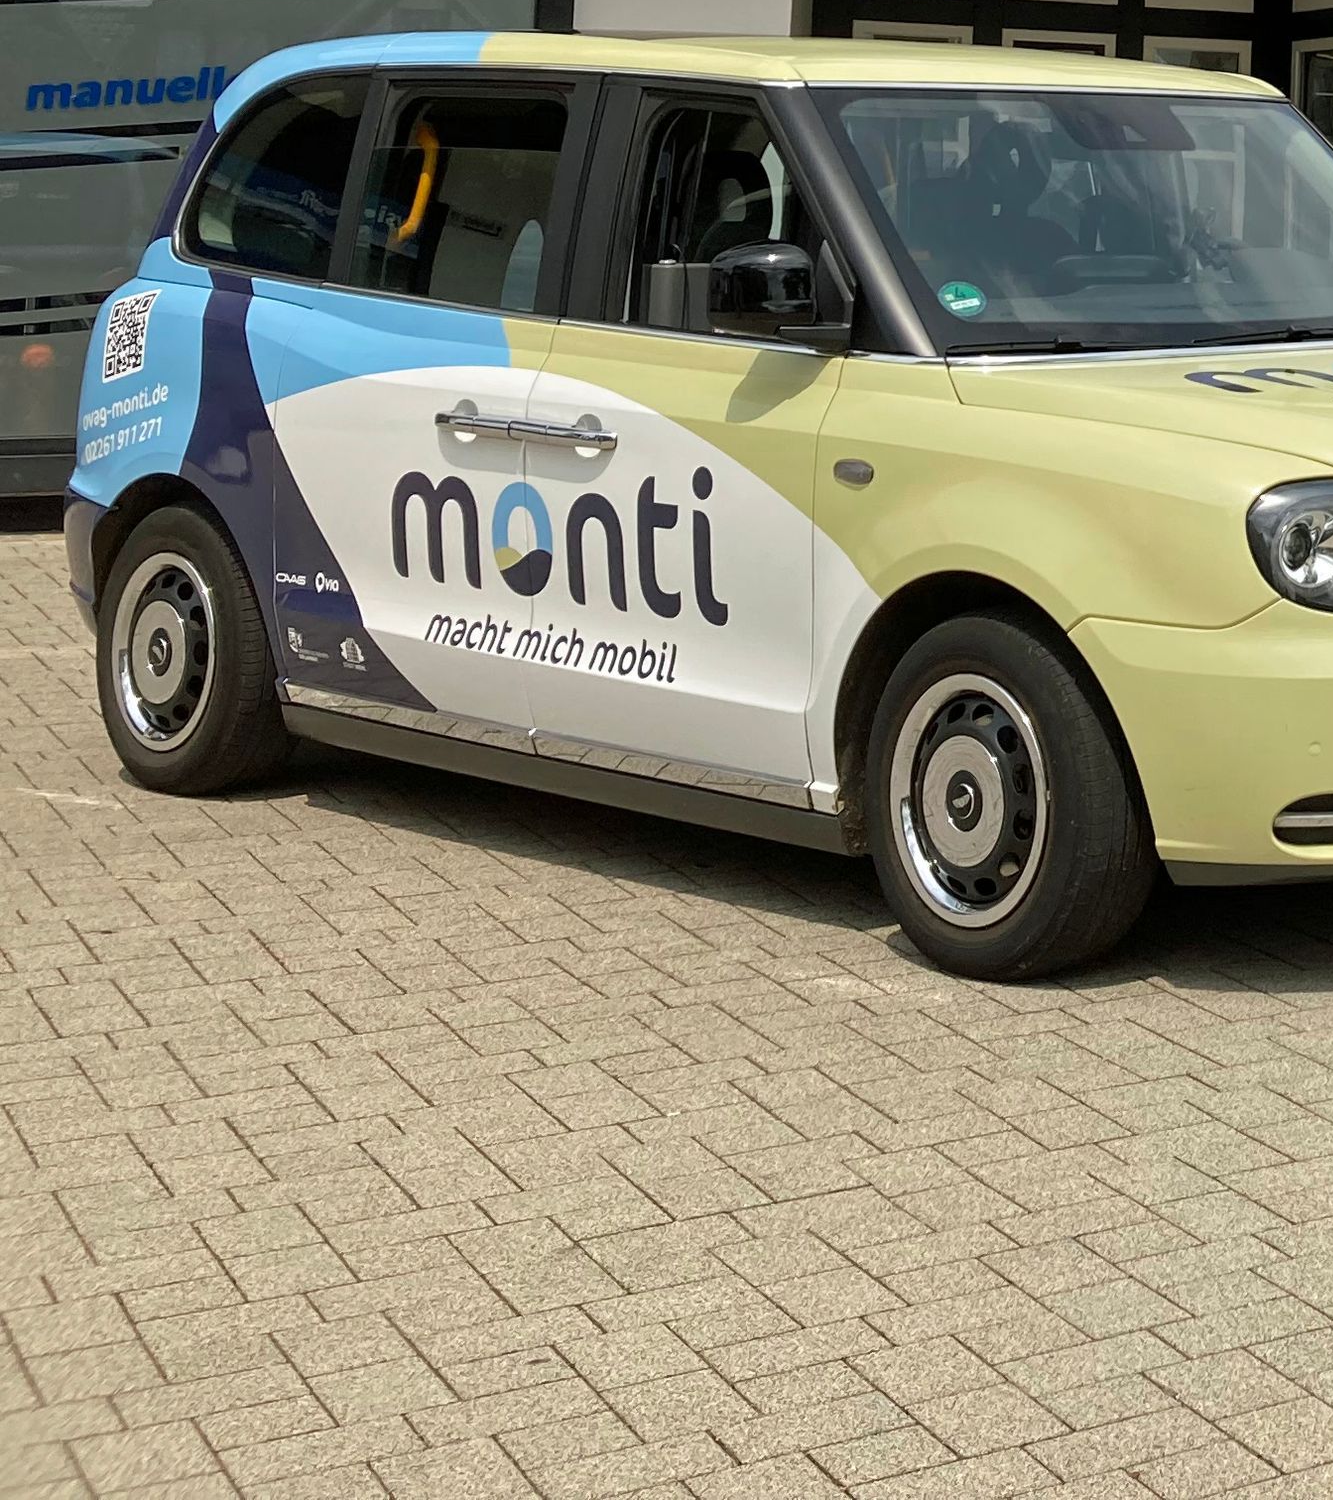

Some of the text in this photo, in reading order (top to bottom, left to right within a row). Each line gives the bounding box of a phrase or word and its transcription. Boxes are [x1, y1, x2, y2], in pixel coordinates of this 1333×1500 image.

[25, 65, 226, 112] manuell
[82, 382, 169, 432] ovag-monti.de
[84, 416, 163, 465] 02261 911 271
[391, 465, 729, 627] monti
[424, 613, 678, 684] macht mich mobil
